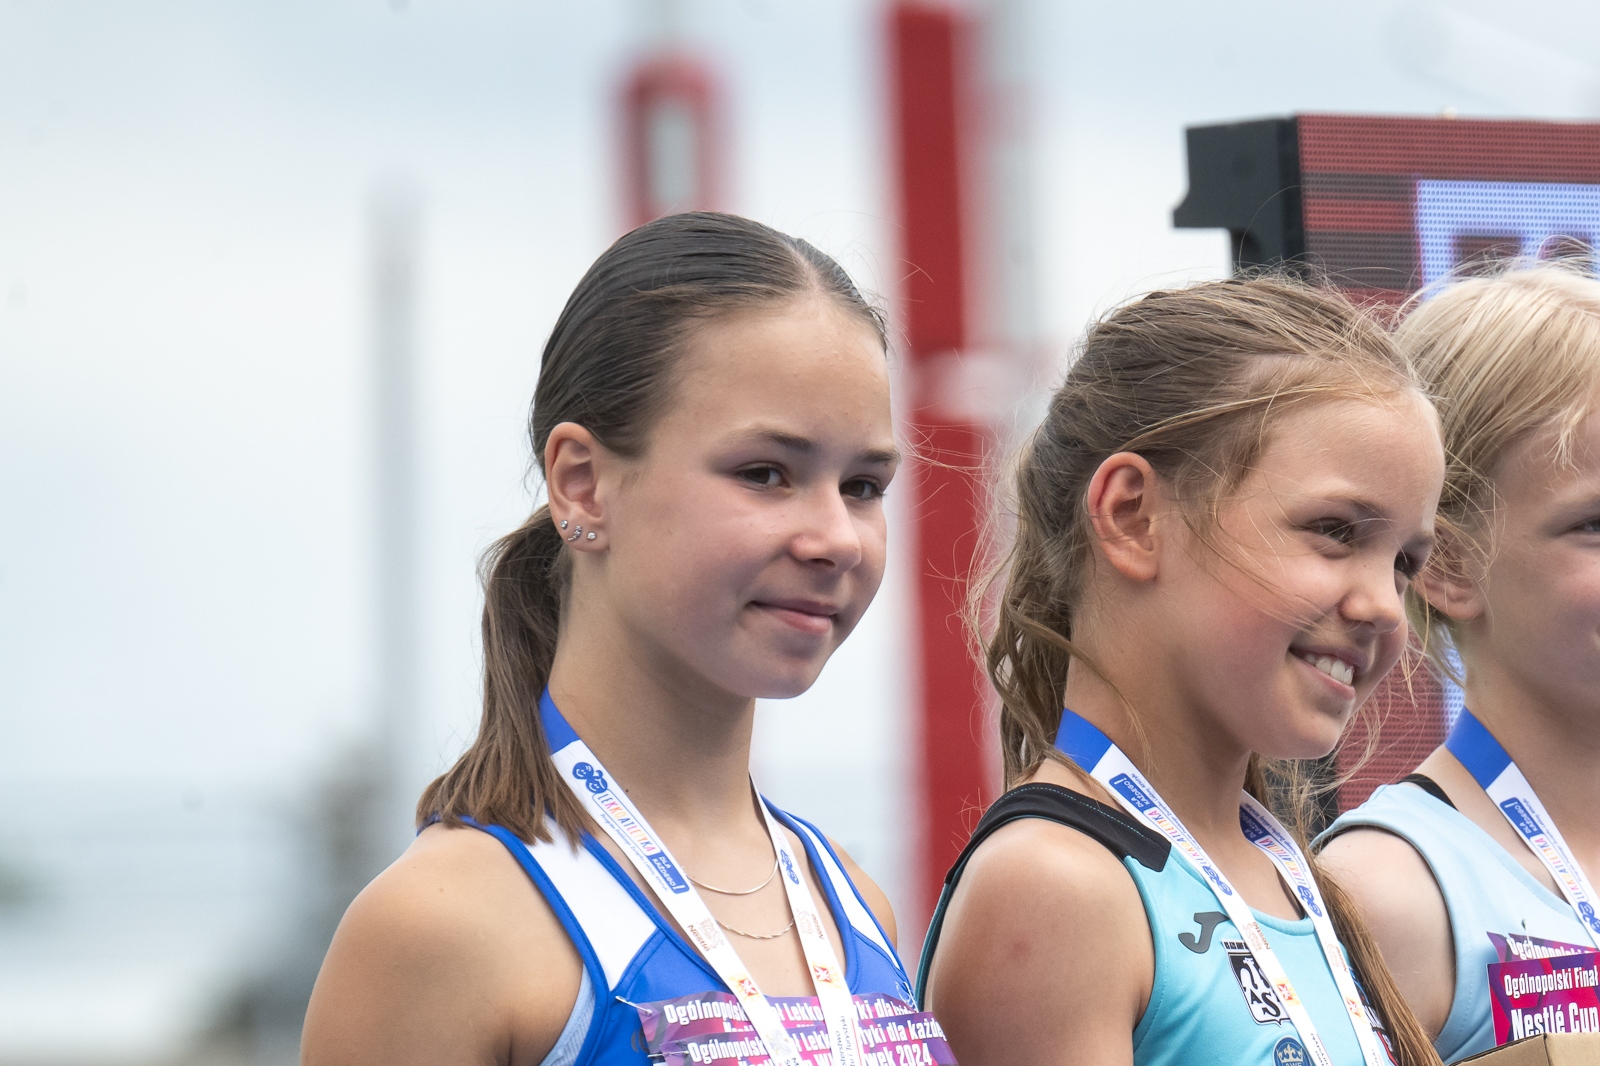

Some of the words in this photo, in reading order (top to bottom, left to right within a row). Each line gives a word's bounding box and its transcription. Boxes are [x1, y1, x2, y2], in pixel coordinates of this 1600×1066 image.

[597, 793, 656, 853] LEKKOATLETYKA
[658, 856, 671, 869] DLA
[1504, 968, 1573, 999] Ogólnopolski
[1574, 964, 1599, 988] Finał
[664, 999, 748, 1025] Ogólnopolsk
[687, 1036, 768, 1064] Ogólnopolsk
[886, 1021, 908, 1042] dla
